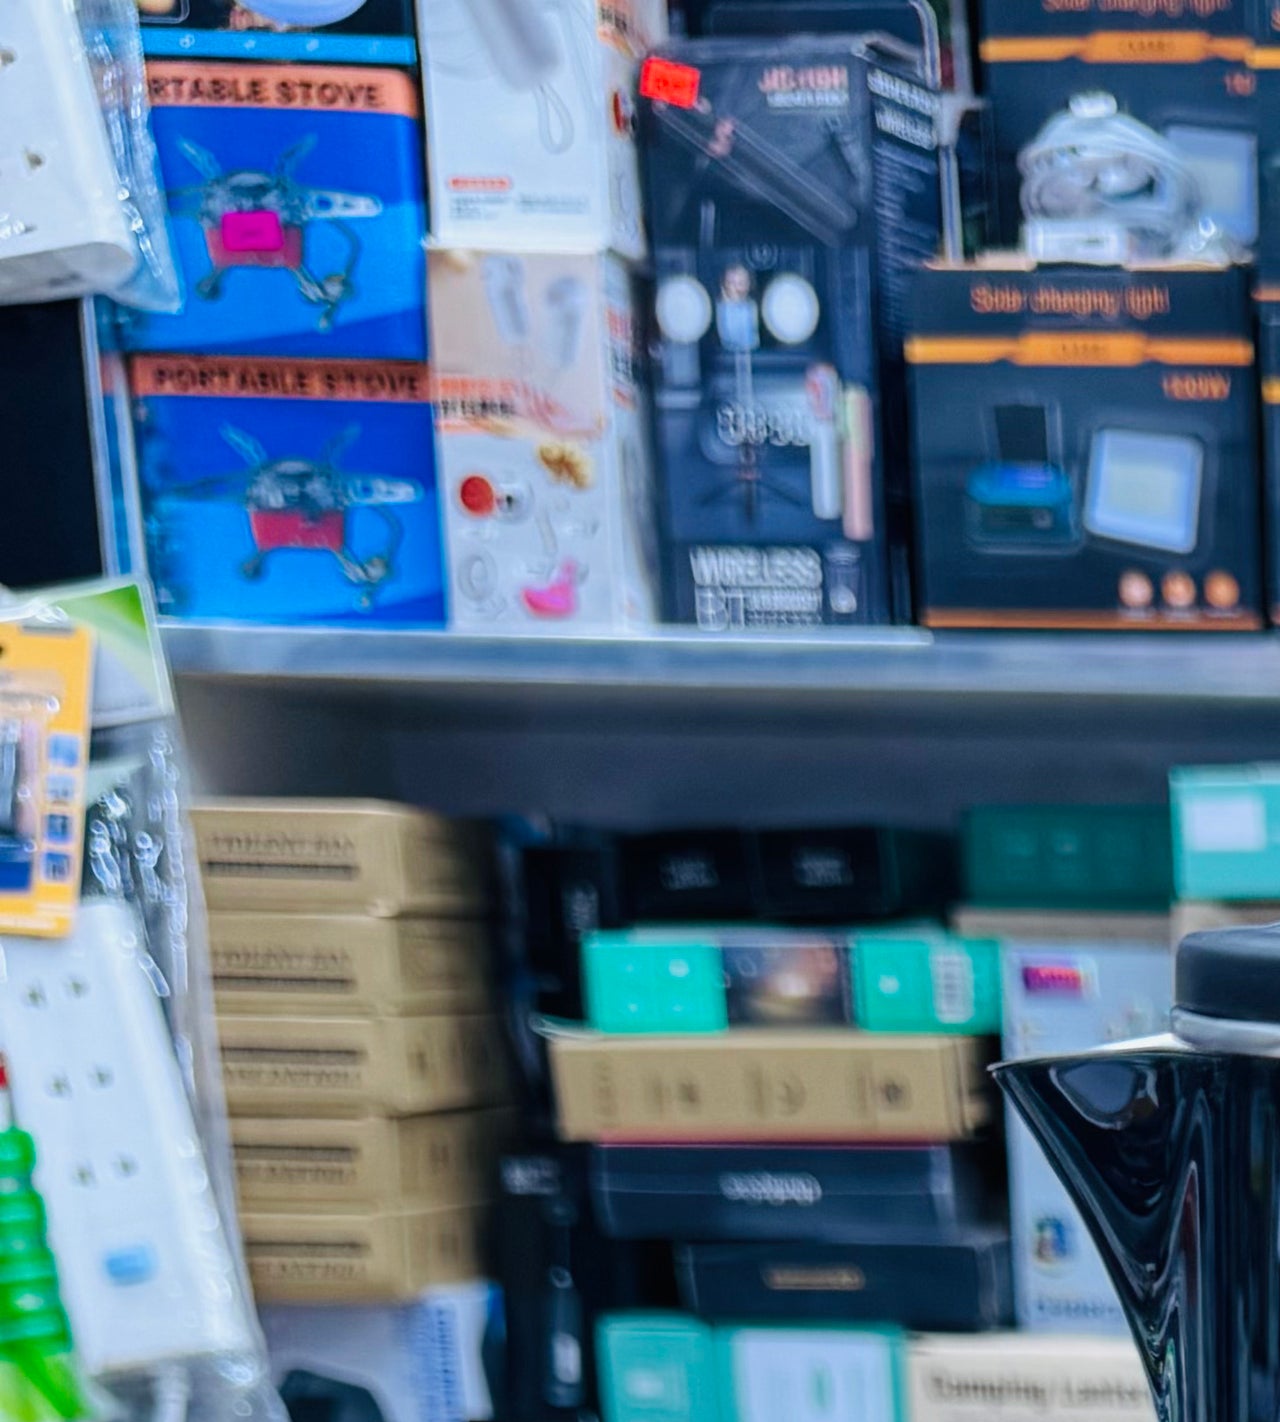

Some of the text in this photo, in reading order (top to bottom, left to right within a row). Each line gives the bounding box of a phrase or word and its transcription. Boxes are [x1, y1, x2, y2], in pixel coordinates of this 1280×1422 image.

[150, 77, 385, 107] RTABLE STOVE
[156, 367, 420, 399] PORTABLE STOVE
